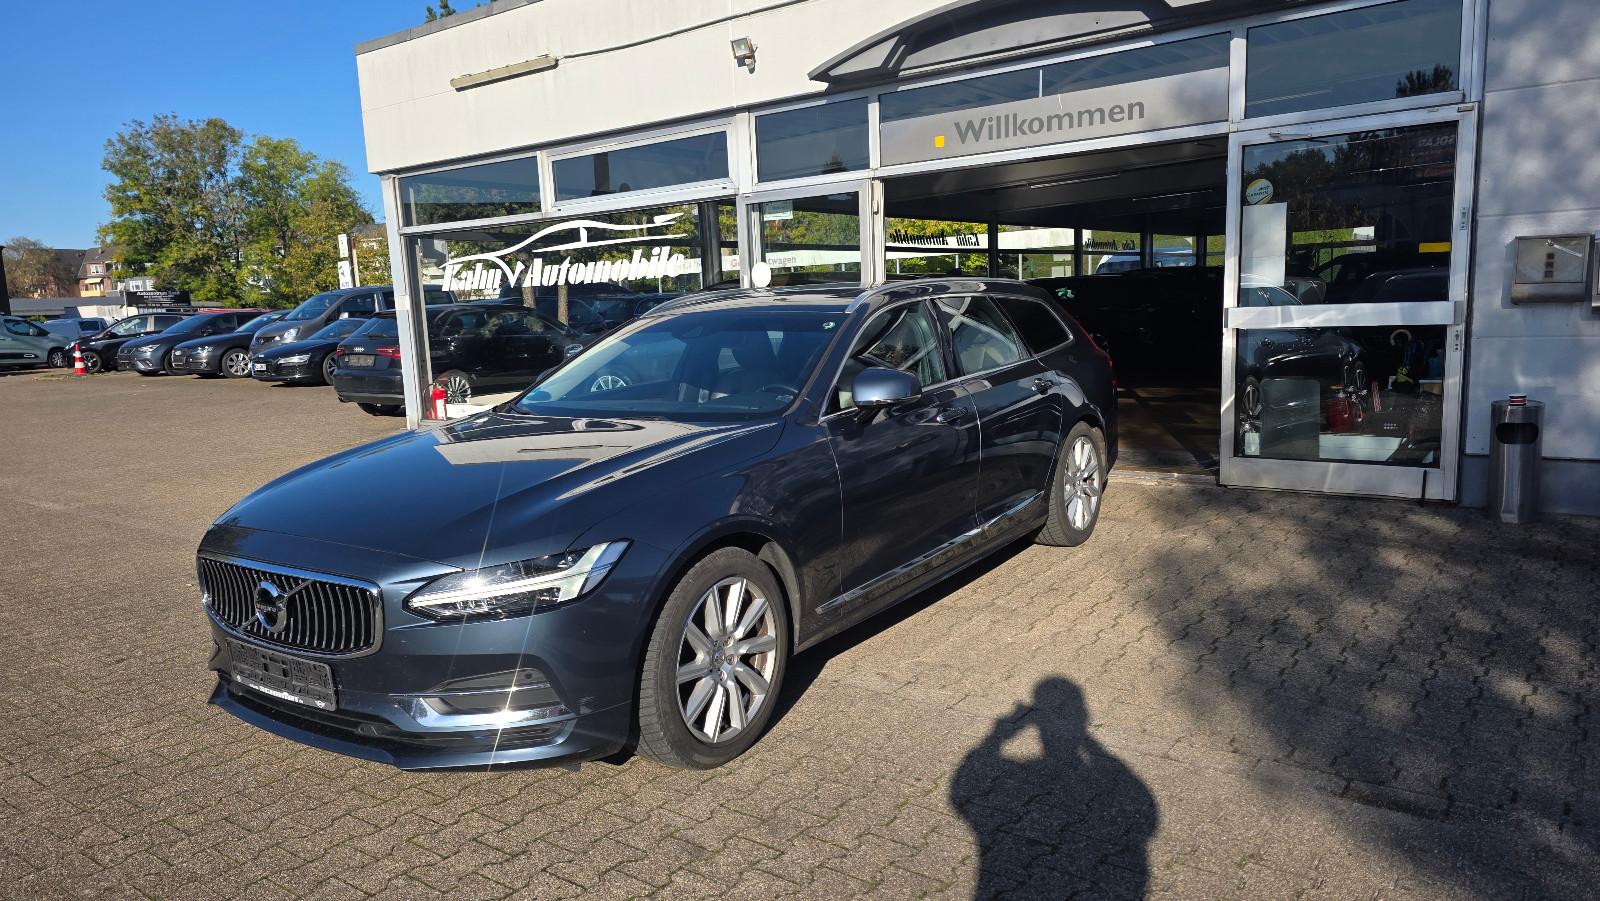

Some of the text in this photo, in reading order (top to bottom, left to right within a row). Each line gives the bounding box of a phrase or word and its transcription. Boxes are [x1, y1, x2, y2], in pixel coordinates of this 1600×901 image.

[954, 100, 1145, 144] Willkommen
[441, 245, 685, 292] Kahn Automobile
